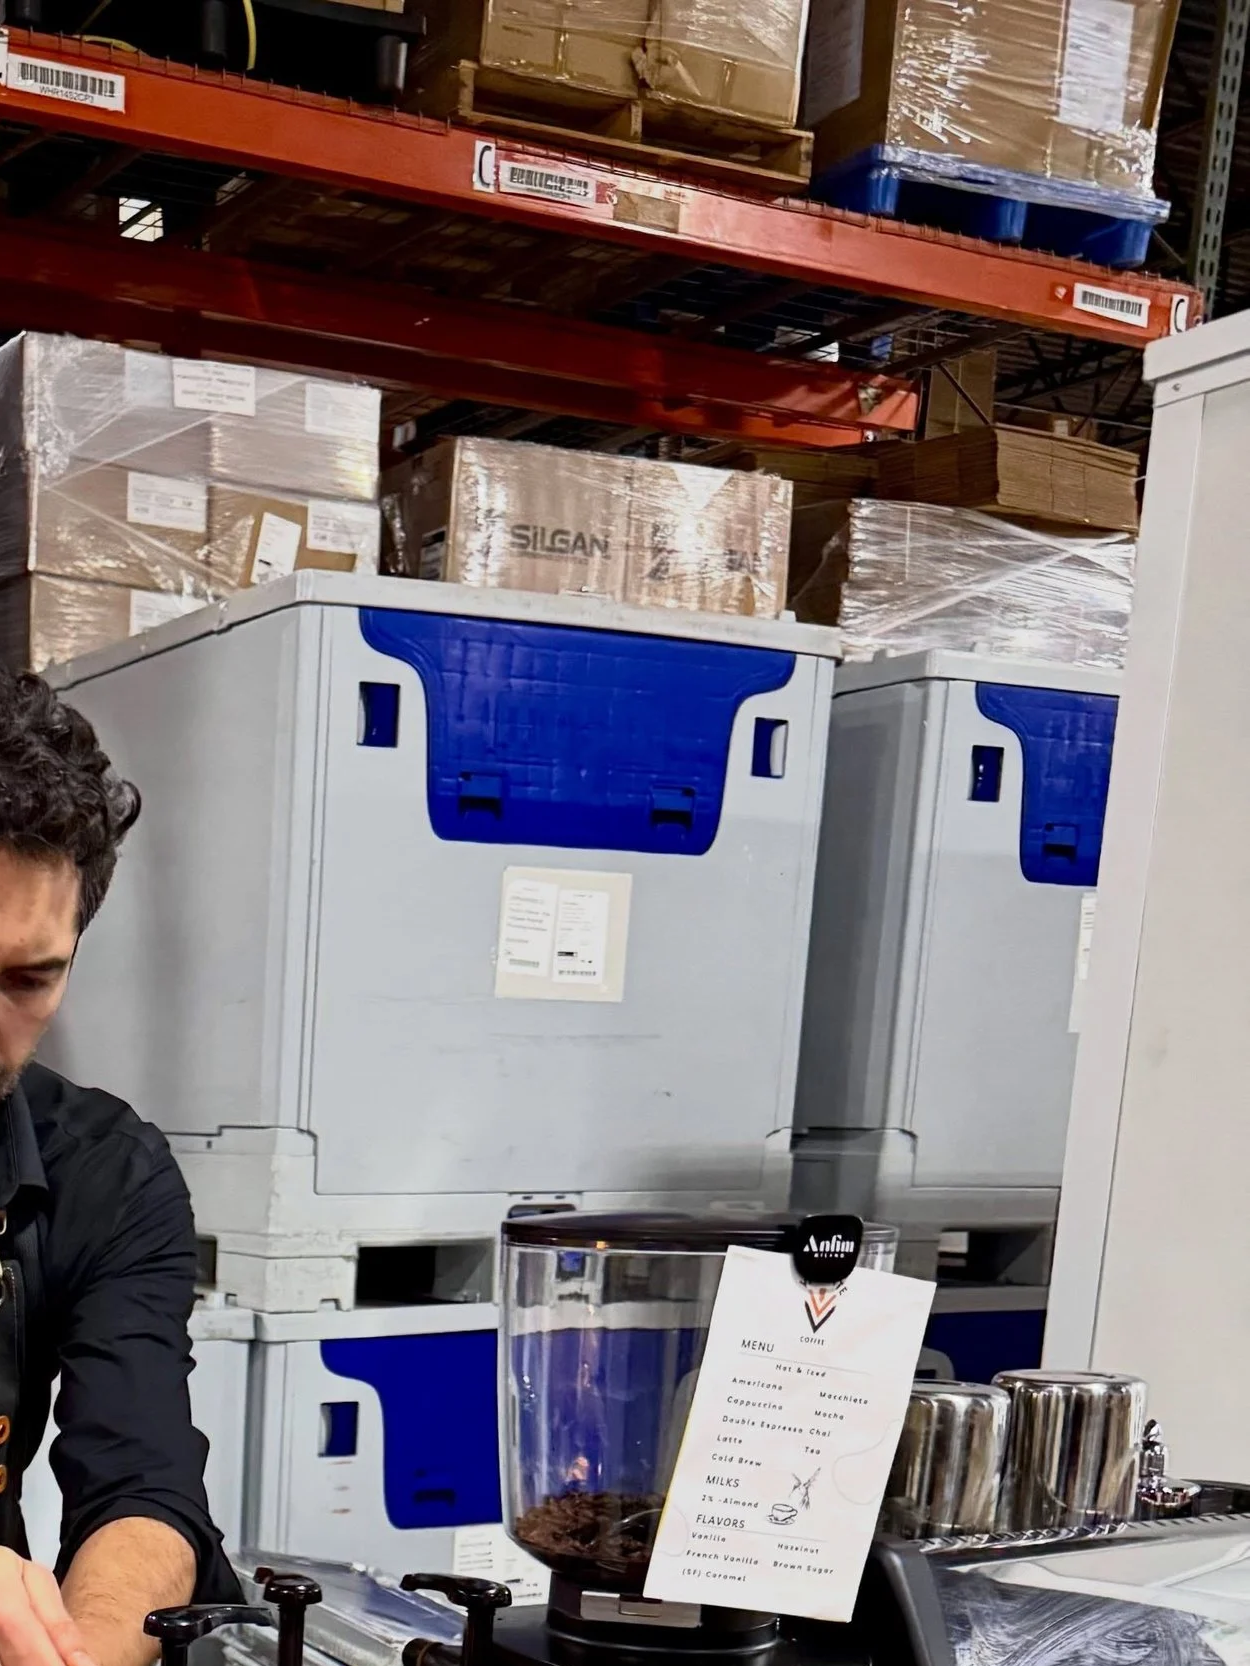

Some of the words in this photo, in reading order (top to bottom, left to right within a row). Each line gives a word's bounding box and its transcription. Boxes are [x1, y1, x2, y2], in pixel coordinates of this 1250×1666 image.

[478, 145, 492, 188] C
[510, 523, 612, 556] SILGAN
[741, 1339, 775, 1352] MENU
[775, 1363, 792, 1373] Hot
[732, 1377, 783, 1391] Americano
[727, 1396, 783, 1411] Cappuccino
[819, 1391, 869, 1405] Macchiato
[814, 1410, 844, 1421] Mocha
[722, 1415, 756, 1427] Double
[760, 1421, 803, 1434] Espresso
[717, 1434, 743, 1444] Latte
[809, 1428, 831, 1438] Chai
[804, 1446, 821, 1455] Tea
[712, 1453, 734, 1463] Cold
[738, 1457, 762, 1467] Brew
[706, 1475, 740, 1488] MILKS
[696, 1514, 745, 1529] FLAVORS
[691, 1532, 726, 1543] Vanilla
[777, 1543, 820, 1555] Hazelnut
[686, 1550, 719, 1560] French
[724, 1554, 759, 1566] Vanilla
[773, 1561, 802, 1570] Brown
[807, 1565, 834, 1576] Sugar
[706, 1571, 746, 1582] Caramel
